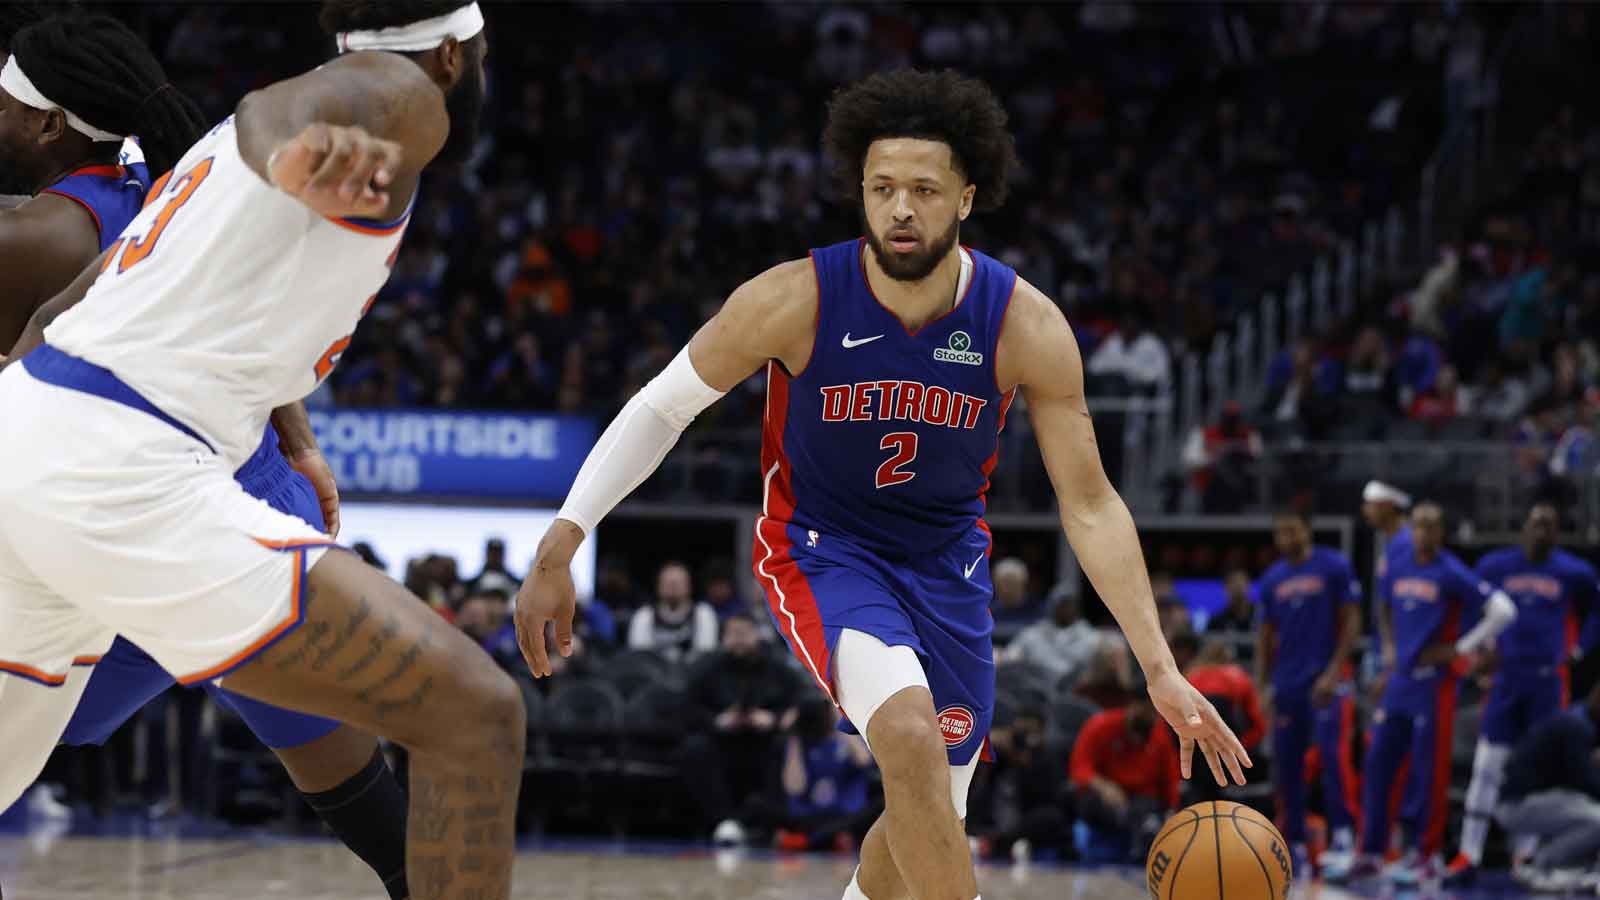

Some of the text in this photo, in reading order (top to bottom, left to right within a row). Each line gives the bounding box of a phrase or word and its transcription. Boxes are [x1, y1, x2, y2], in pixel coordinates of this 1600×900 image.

[935, 349, 981, 363] StockX
[820, 380, 988, 429] DETROIT
[335, 453, 420, 491] LUB
[875, 432, 918, 488] 2
[941, 716, 968, 729] DETROIT
